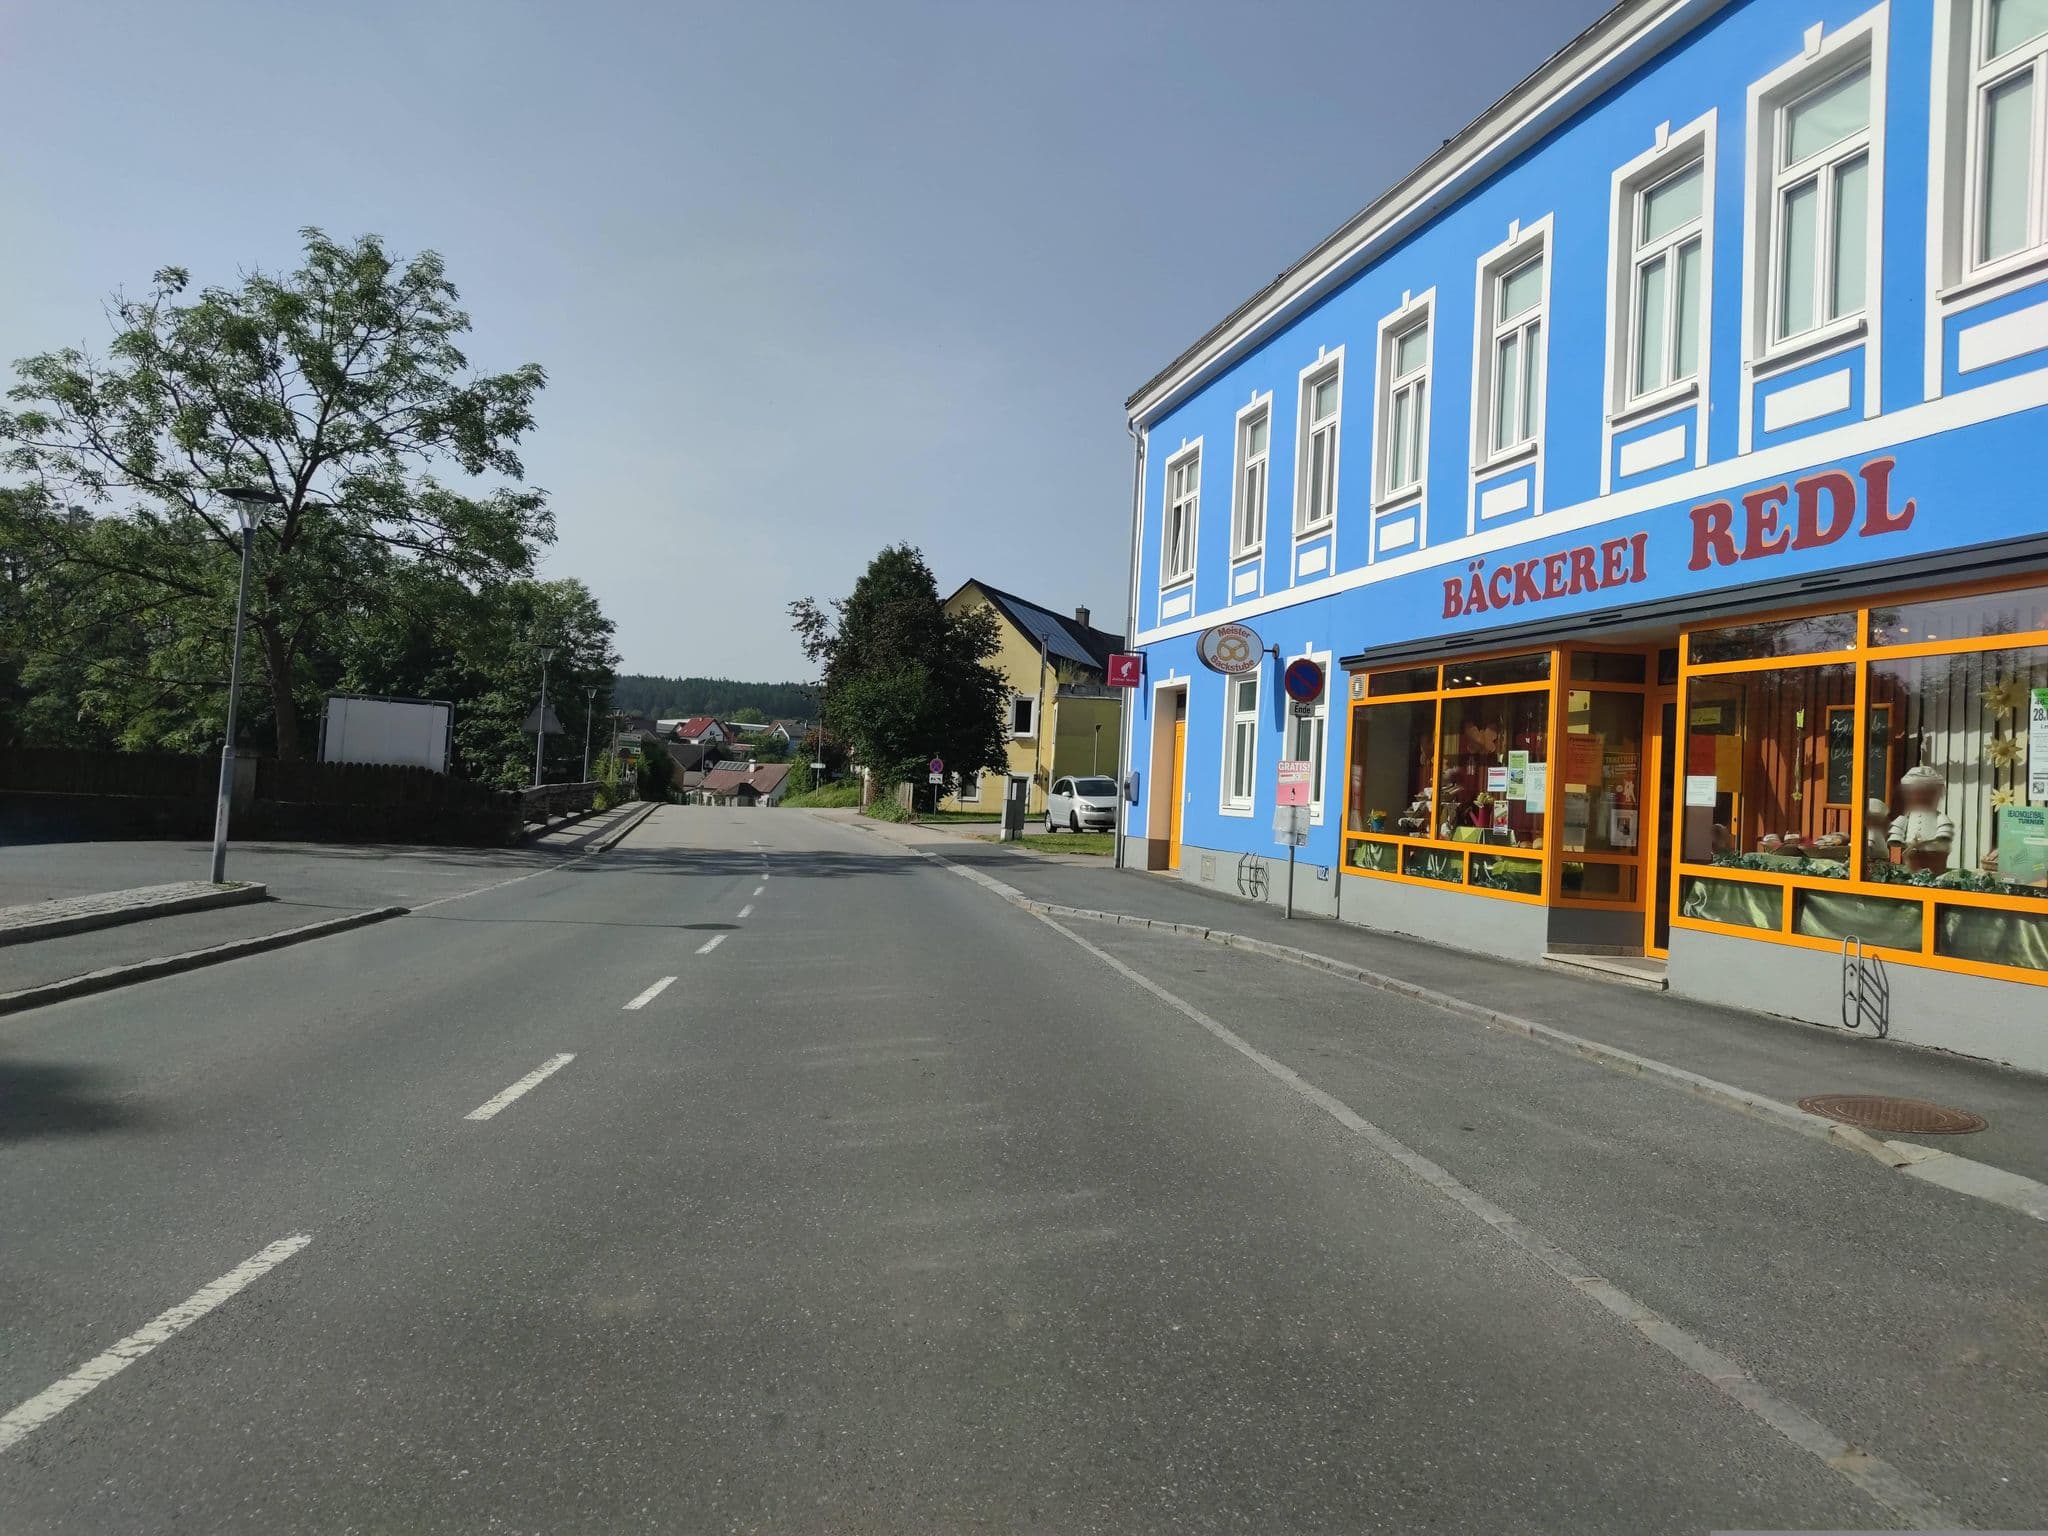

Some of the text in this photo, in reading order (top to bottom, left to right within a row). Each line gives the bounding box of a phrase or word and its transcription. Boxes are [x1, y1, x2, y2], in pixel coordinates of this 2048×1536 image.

[1442, 456, 1916, 619] BÄCKEREI REDL
[1217, 625, 1251, 638] Meister
[1294, 704, 1311, 714] Ende
[1278, 761, 1311, 772] GRATIS!
